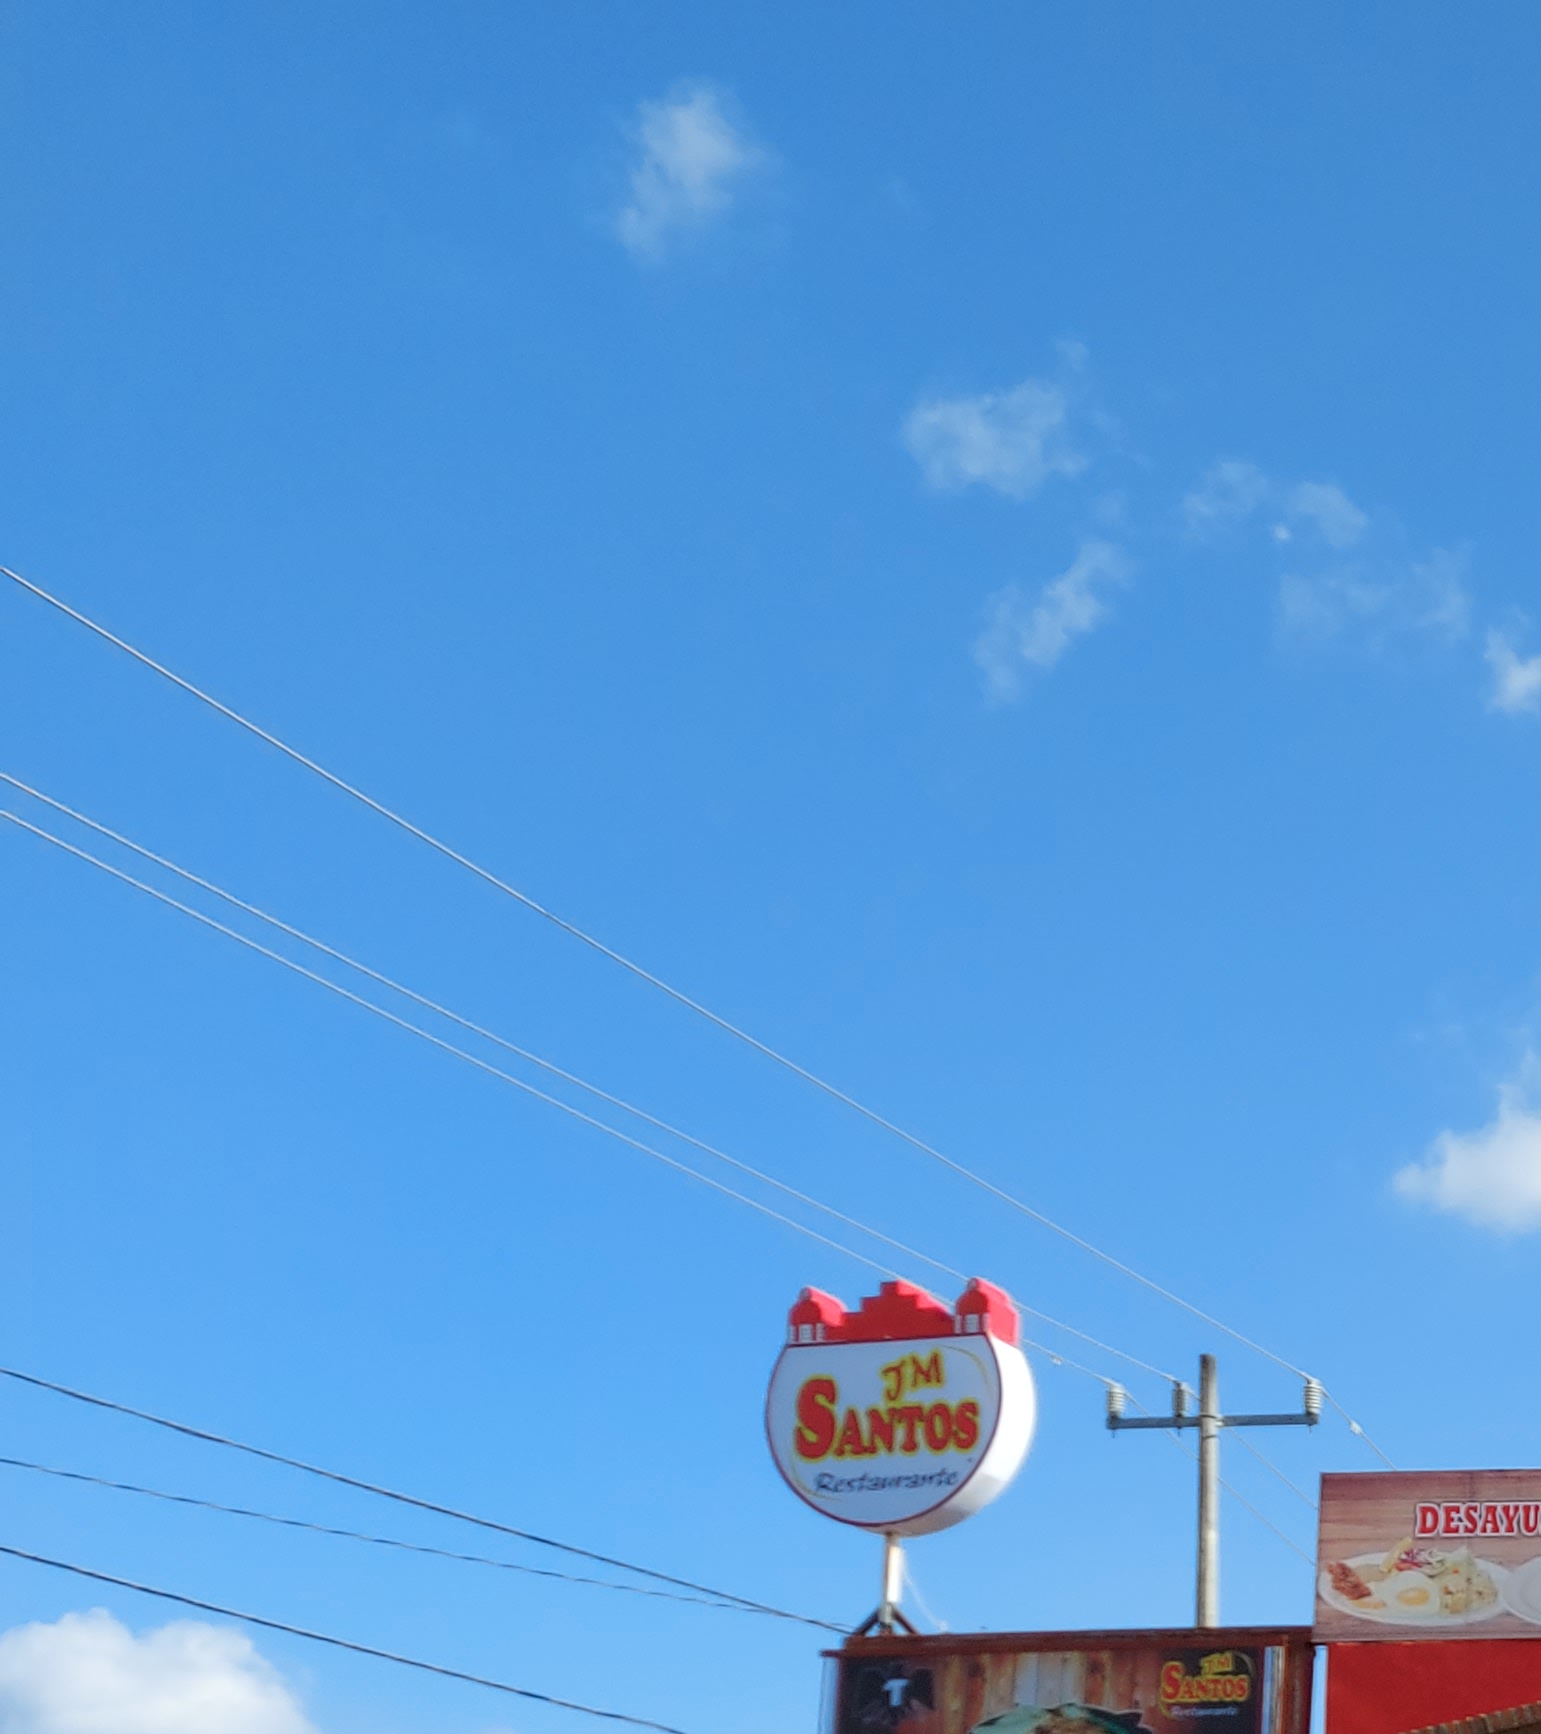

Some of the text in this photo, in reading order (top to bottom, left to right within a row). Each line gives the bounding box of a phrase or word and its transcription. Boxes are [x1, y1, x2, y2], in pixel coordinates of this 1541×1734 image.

[880, 1350, 943, 1401] JM
[794, 1377, 980, 1460] SANTOS
[813, 1468, 958, 1493] Restaurante
[1161, 1663, 1248, 1700] SANTOS
